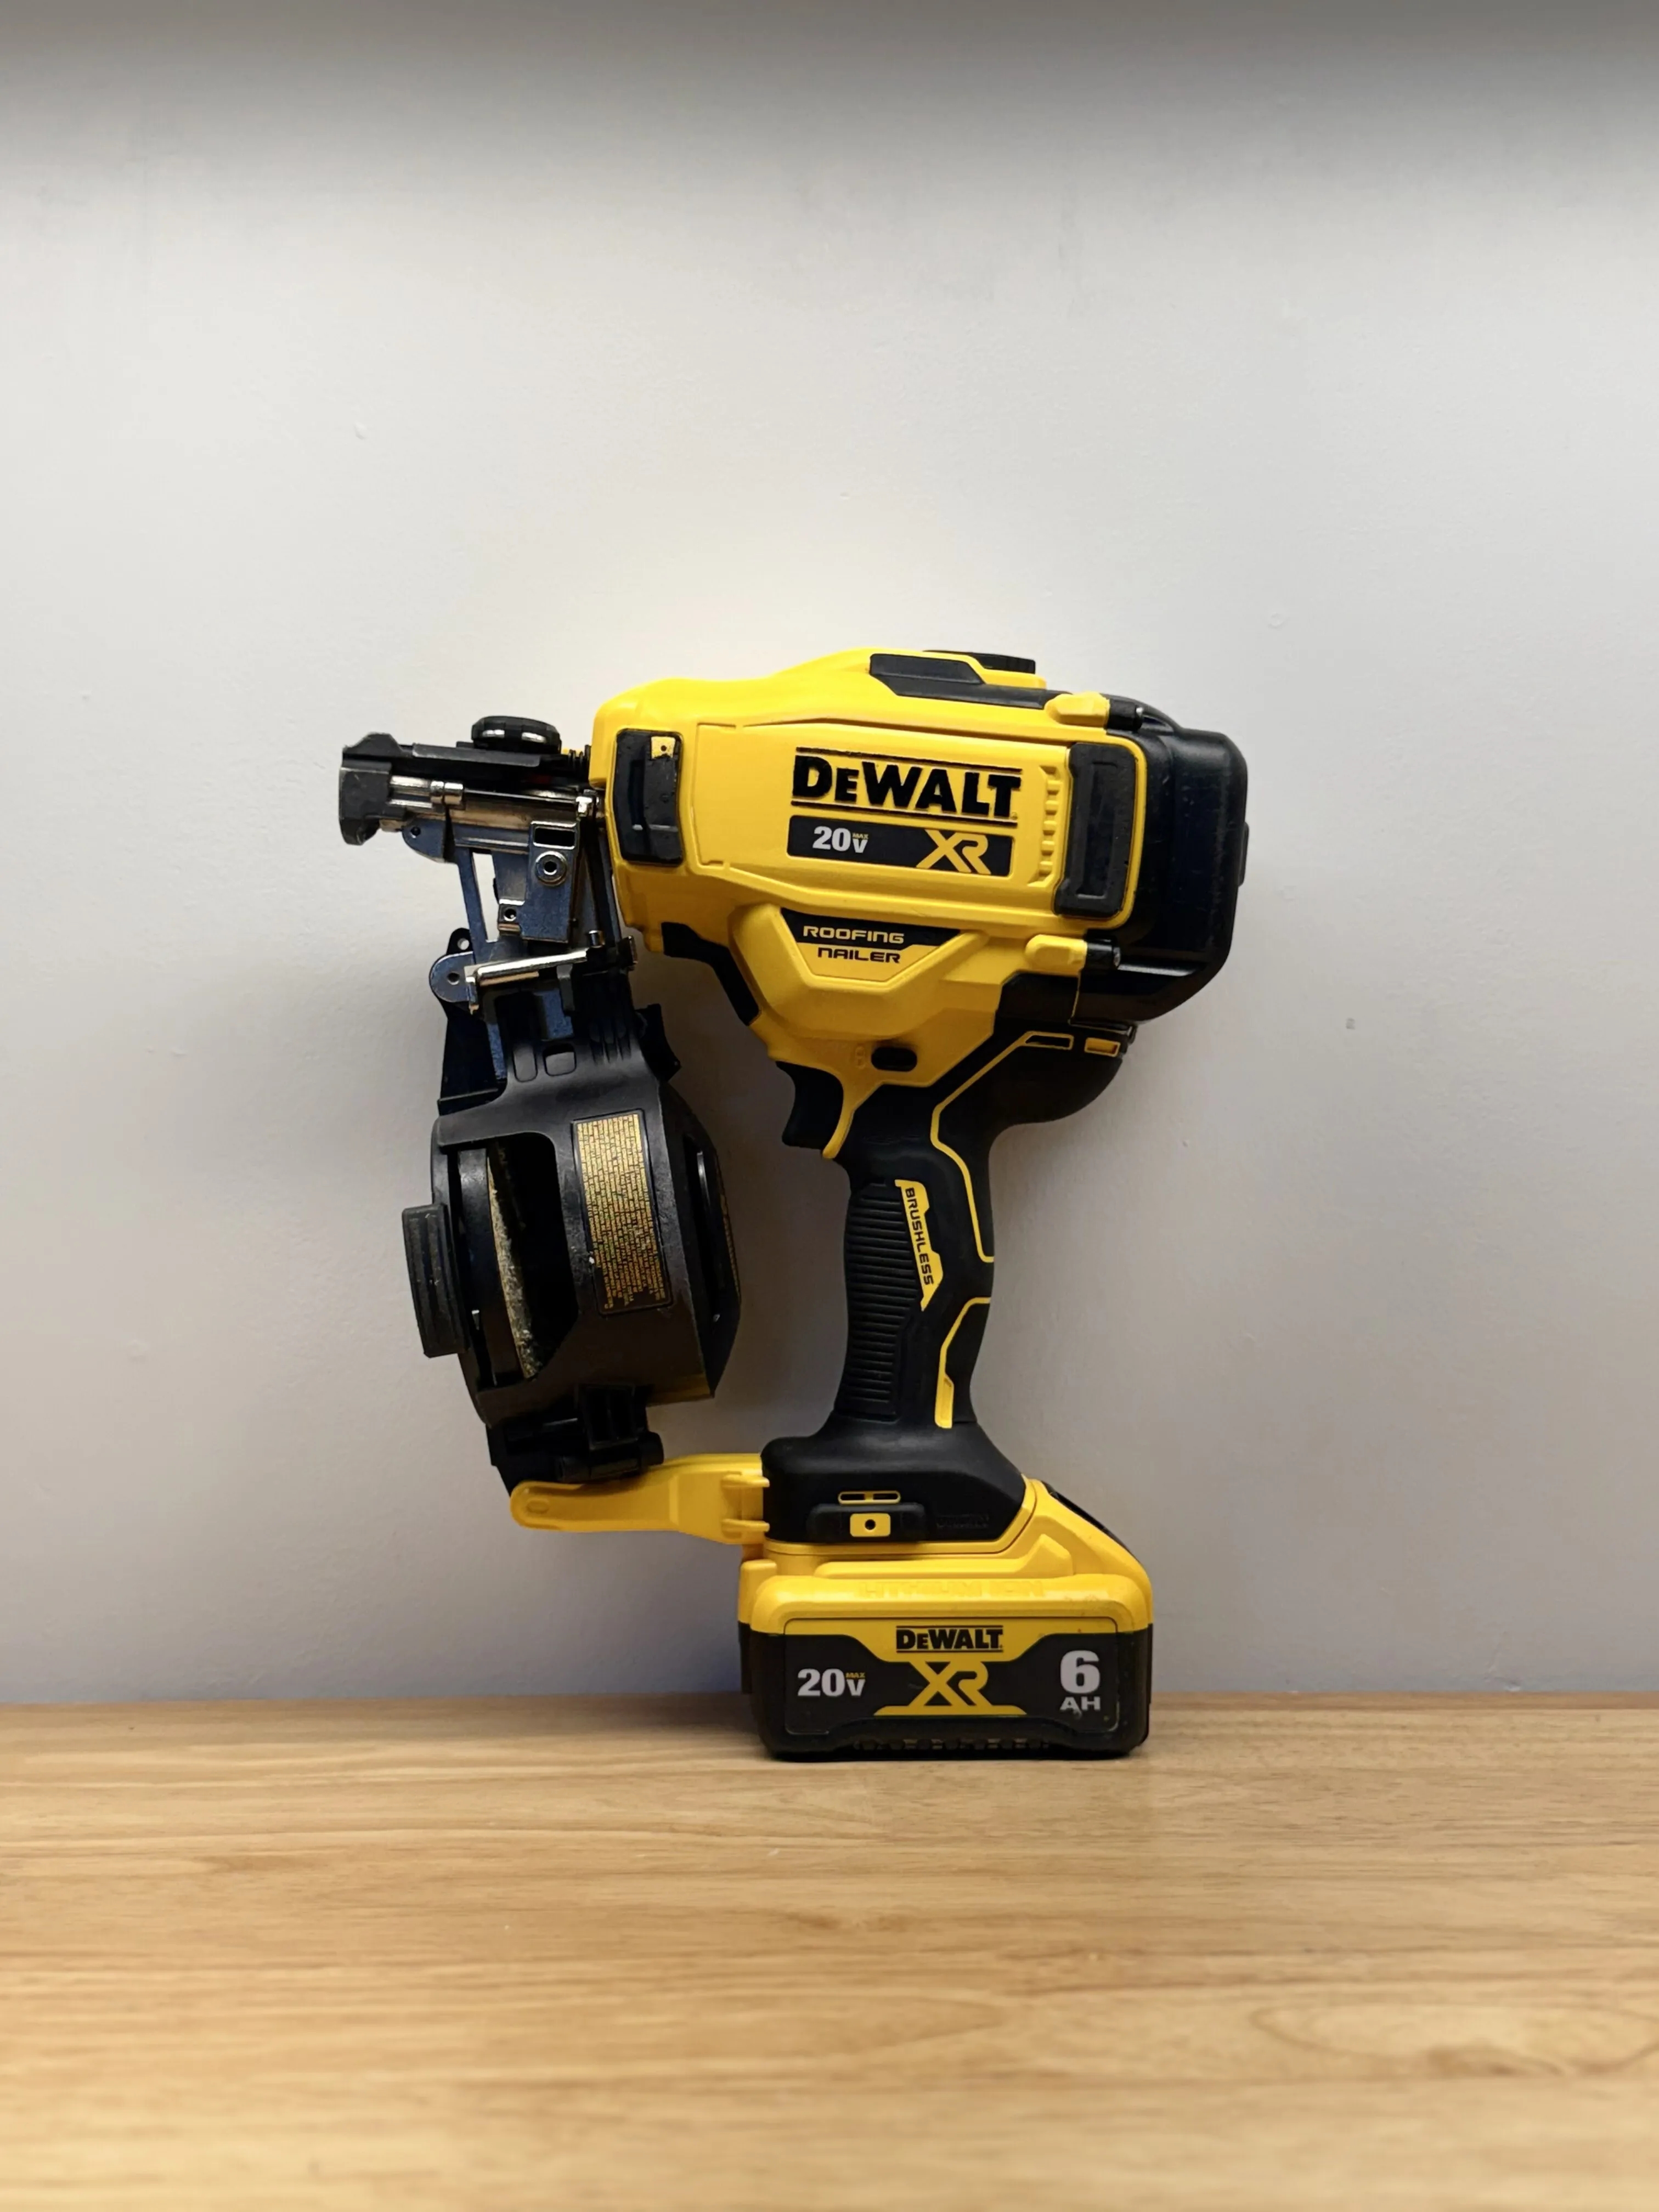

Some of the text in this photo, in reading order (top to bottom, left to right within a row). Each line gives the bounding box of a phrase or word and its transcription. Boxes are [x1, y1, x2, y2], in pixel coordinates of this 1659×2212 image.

[917, 829, 991, 875] XR
[803, 926, 904, 944] ROOFING
[818, 947, 900, 963] NAILER
[905, 1187, 934, 1285] BRUSHLESS
[905, 1661, 994, 1709] XR
[1060, 1650, 1101, 1694] 6
[1059, 1696, 1101, 1712] AH
